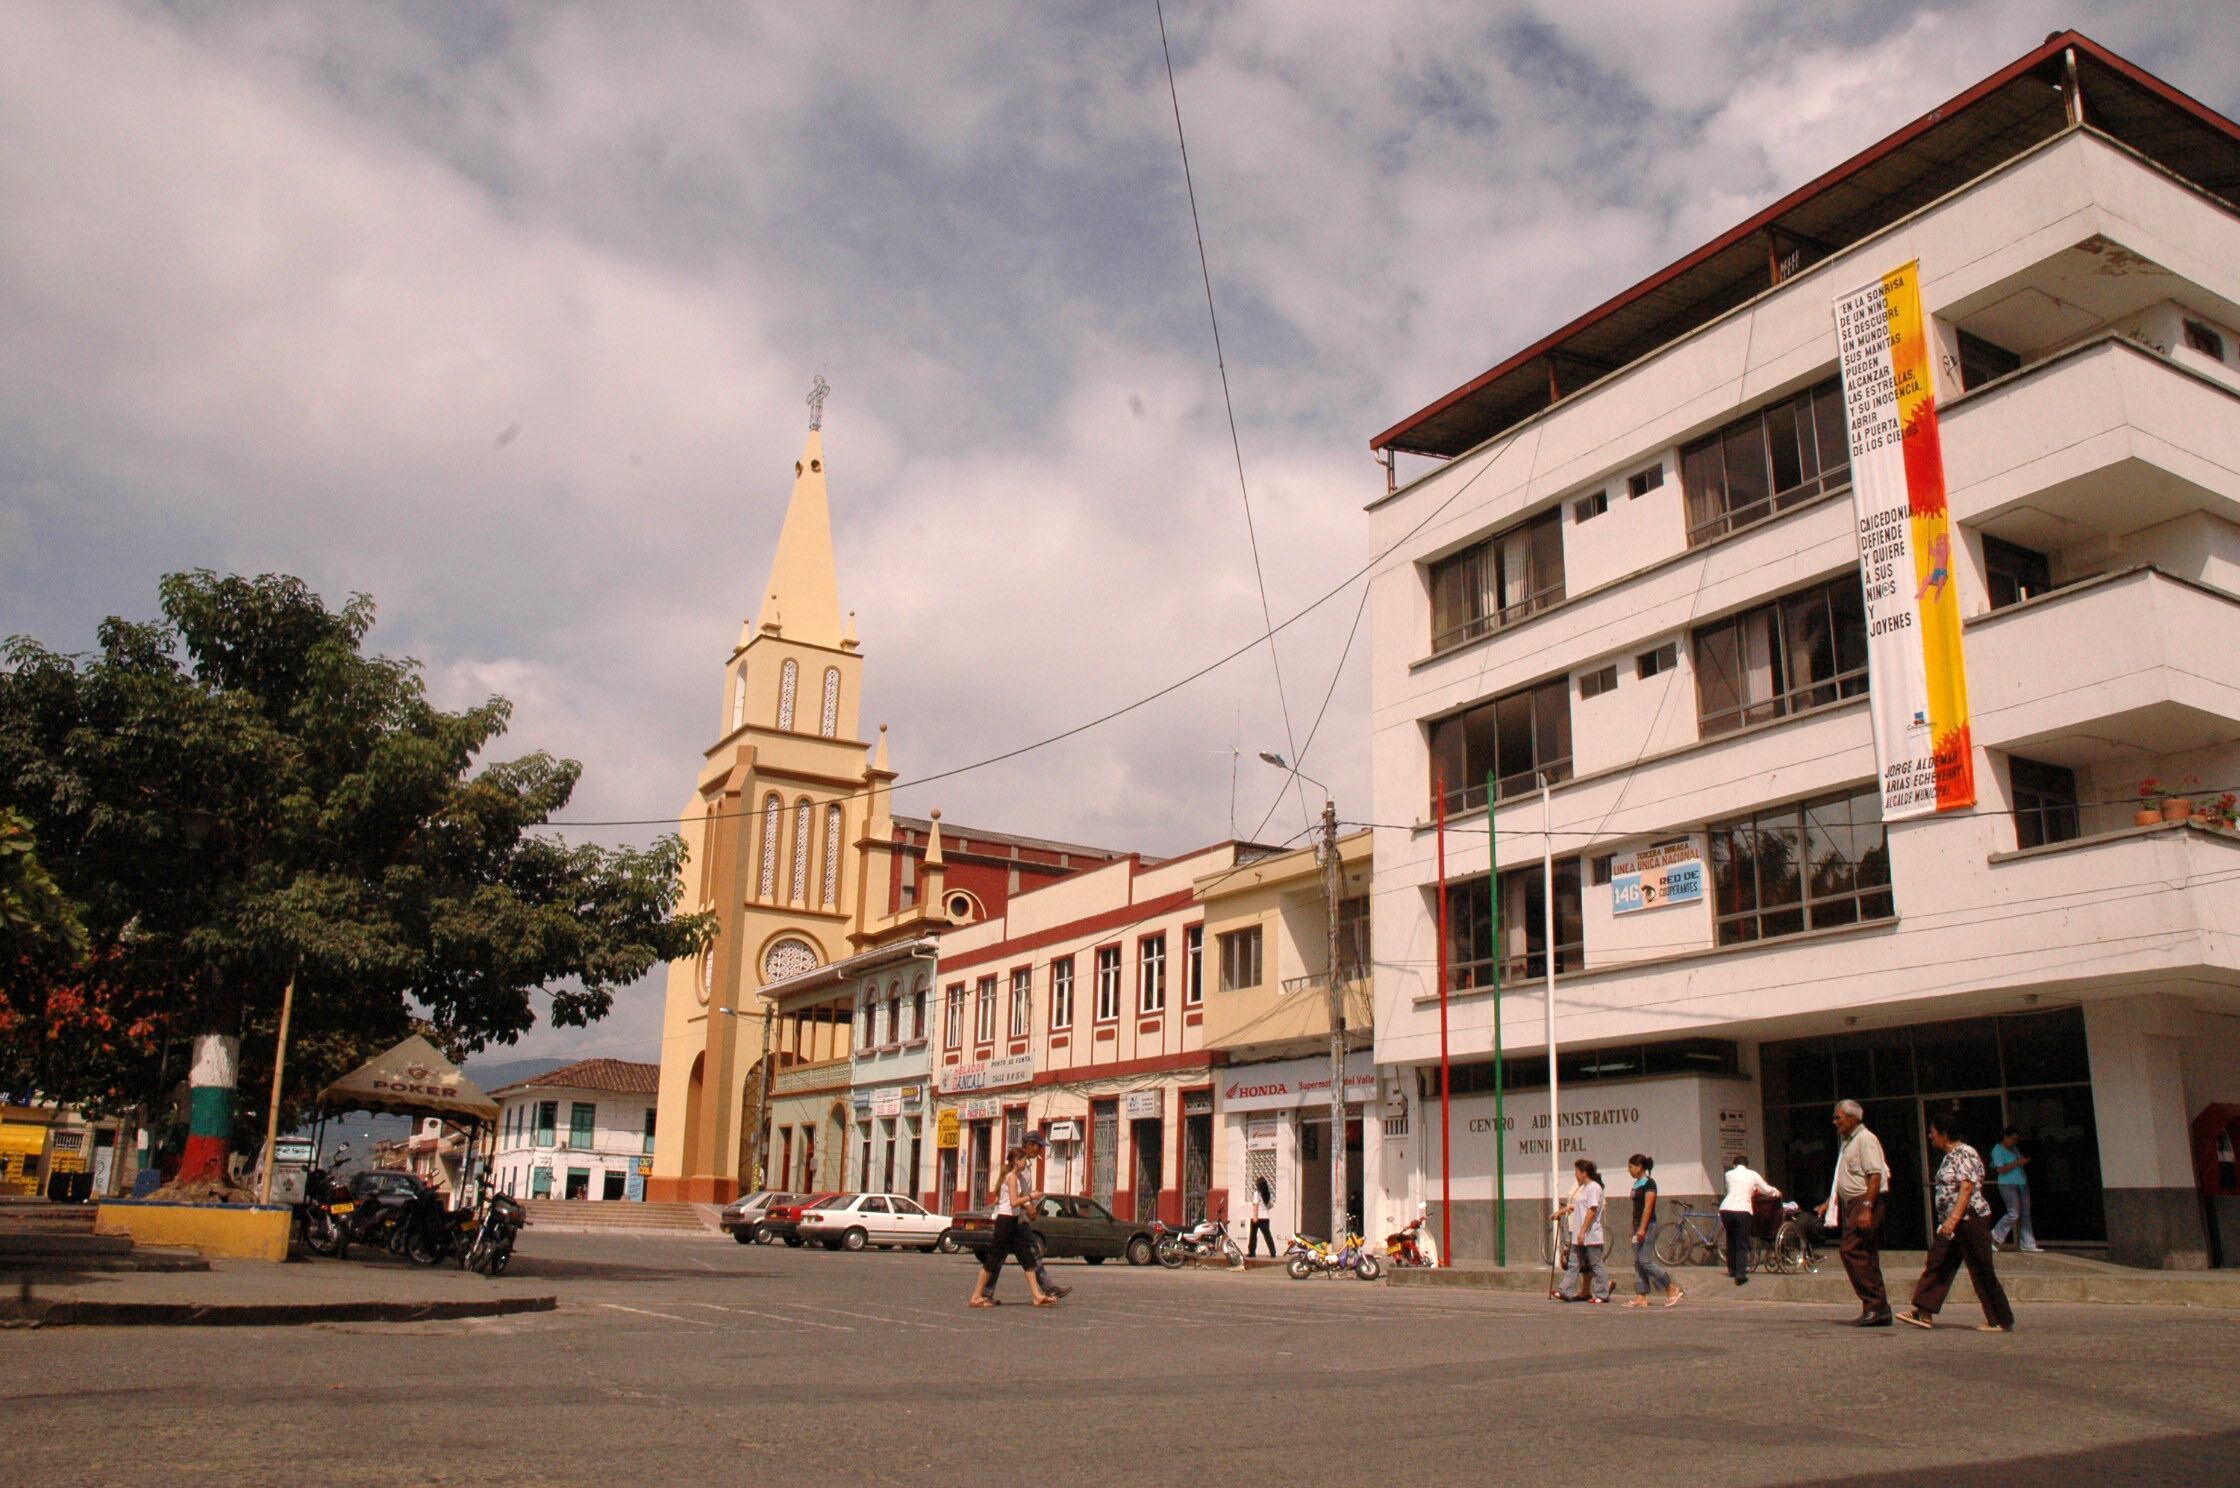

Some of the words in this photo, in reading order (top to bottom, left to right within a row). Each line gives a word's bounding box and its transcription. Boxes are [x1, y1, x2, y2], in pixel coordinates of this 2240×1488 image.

[1855, 296, 1864, 308] LA
[1867, 276, 1904, 302] SONRISA
[1840, 315, 1850, 328] DE
[1853, 309, 1865, 322] UN
[1842, 328, 1852, 340] SE
[1854, 306, 1899, 335] DESCUBRE
[1843, 340, 1854, 353] UN
[1845, 350, 1862, 366] SUS
[1865, 333, 1901, 357] MANITAS
[1846, 357, 1879, 379] PUEDEN
[1848, 366, 1890, 391] ALCANZAR
[1848, 391, 1862, 405] LAS
[1850, 407, 1854, 416] Y
[1858, 401, 1870, 414] SU
[1852, 412, 1878, 430] ABRIR
[1852, 431, 1861, 444] LA
[1865, 417, 1898, 439] PUERTA
[1853, 444, 1863, 456] DE
[1867, 436, 1883, 452] LOS
[1860, 504, 1913, 533] CAICEDONIA
[1861, 525, 1903, 550] DEFIENDE
[1863, 553, 1869, 567] Y
[1873, 541, 1905, 563] QUIERE
[1866, 570, 1871, 584] A
[1875, 563, 1893, 581] SUS
[1868, 605, 1874, 619] Y
[1870, 612, 1911, 637] JOVENES
[1885, 761, 1912, 778] JORGE
[1886, 777, 1910, 793] ARIAS
[1886, 791, 1912, 808] ALCALDE
[1662, 848, 1700, 866] NACIONAL
[1659, 874, 1681, 886] RED
[1684, 870, 1699, 879] DE
[1614, 884, 1639, 904] 146
[373, 1080, 457, 1098] POKER
[1239, 1083, 1288, 1098] HONDA
[1532, 1108, 1639, 1129] ADINISTRATIVO
